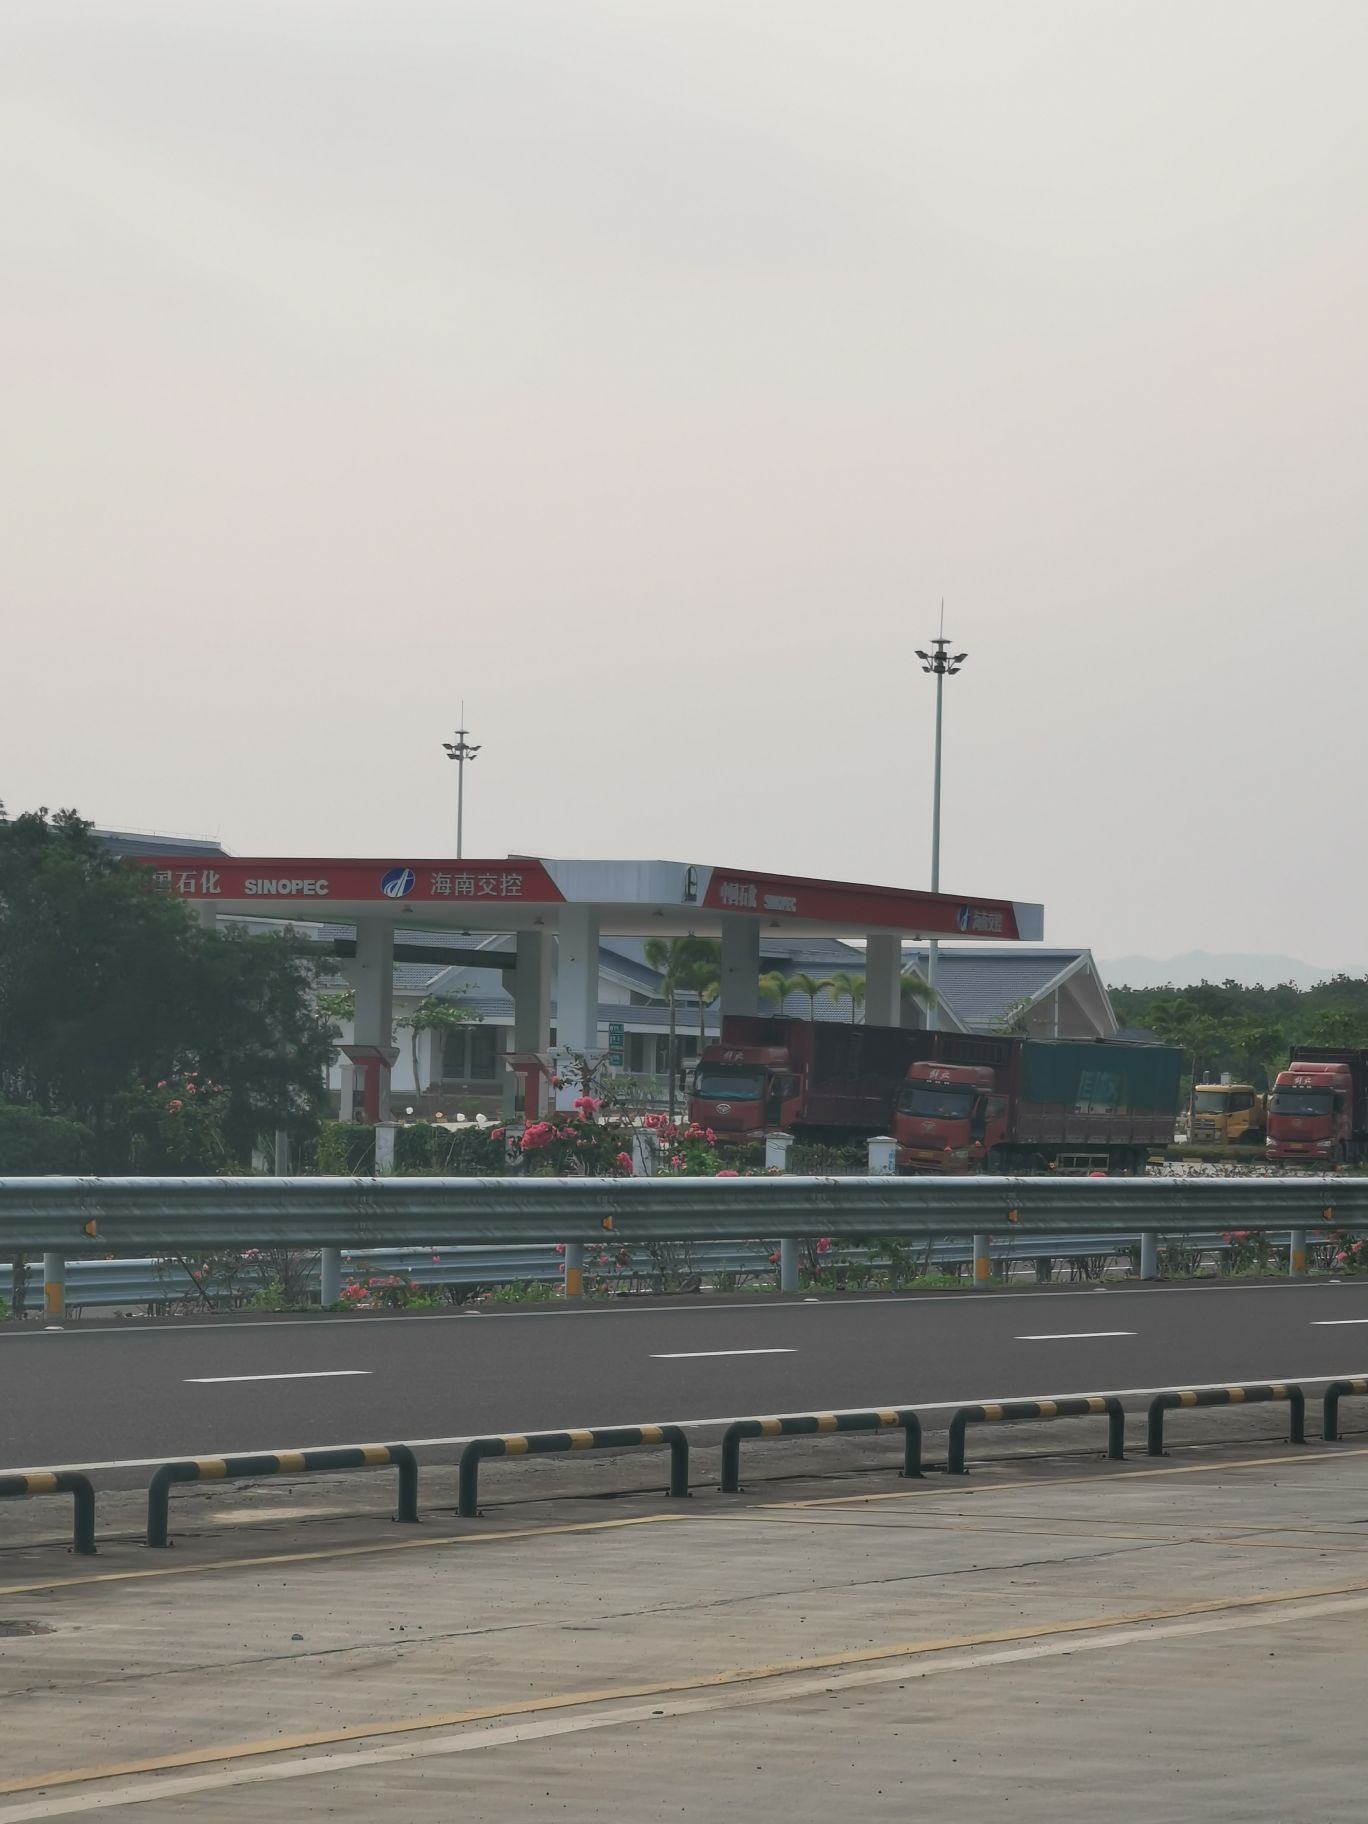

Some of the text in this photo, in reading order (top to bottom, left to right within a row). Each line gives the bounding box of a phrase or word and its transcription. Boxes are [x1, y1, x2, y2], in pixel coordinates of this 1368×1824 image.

[244, 879, 329, 896] SINOPEC
[431, 872, 522, 896] 海南交控
